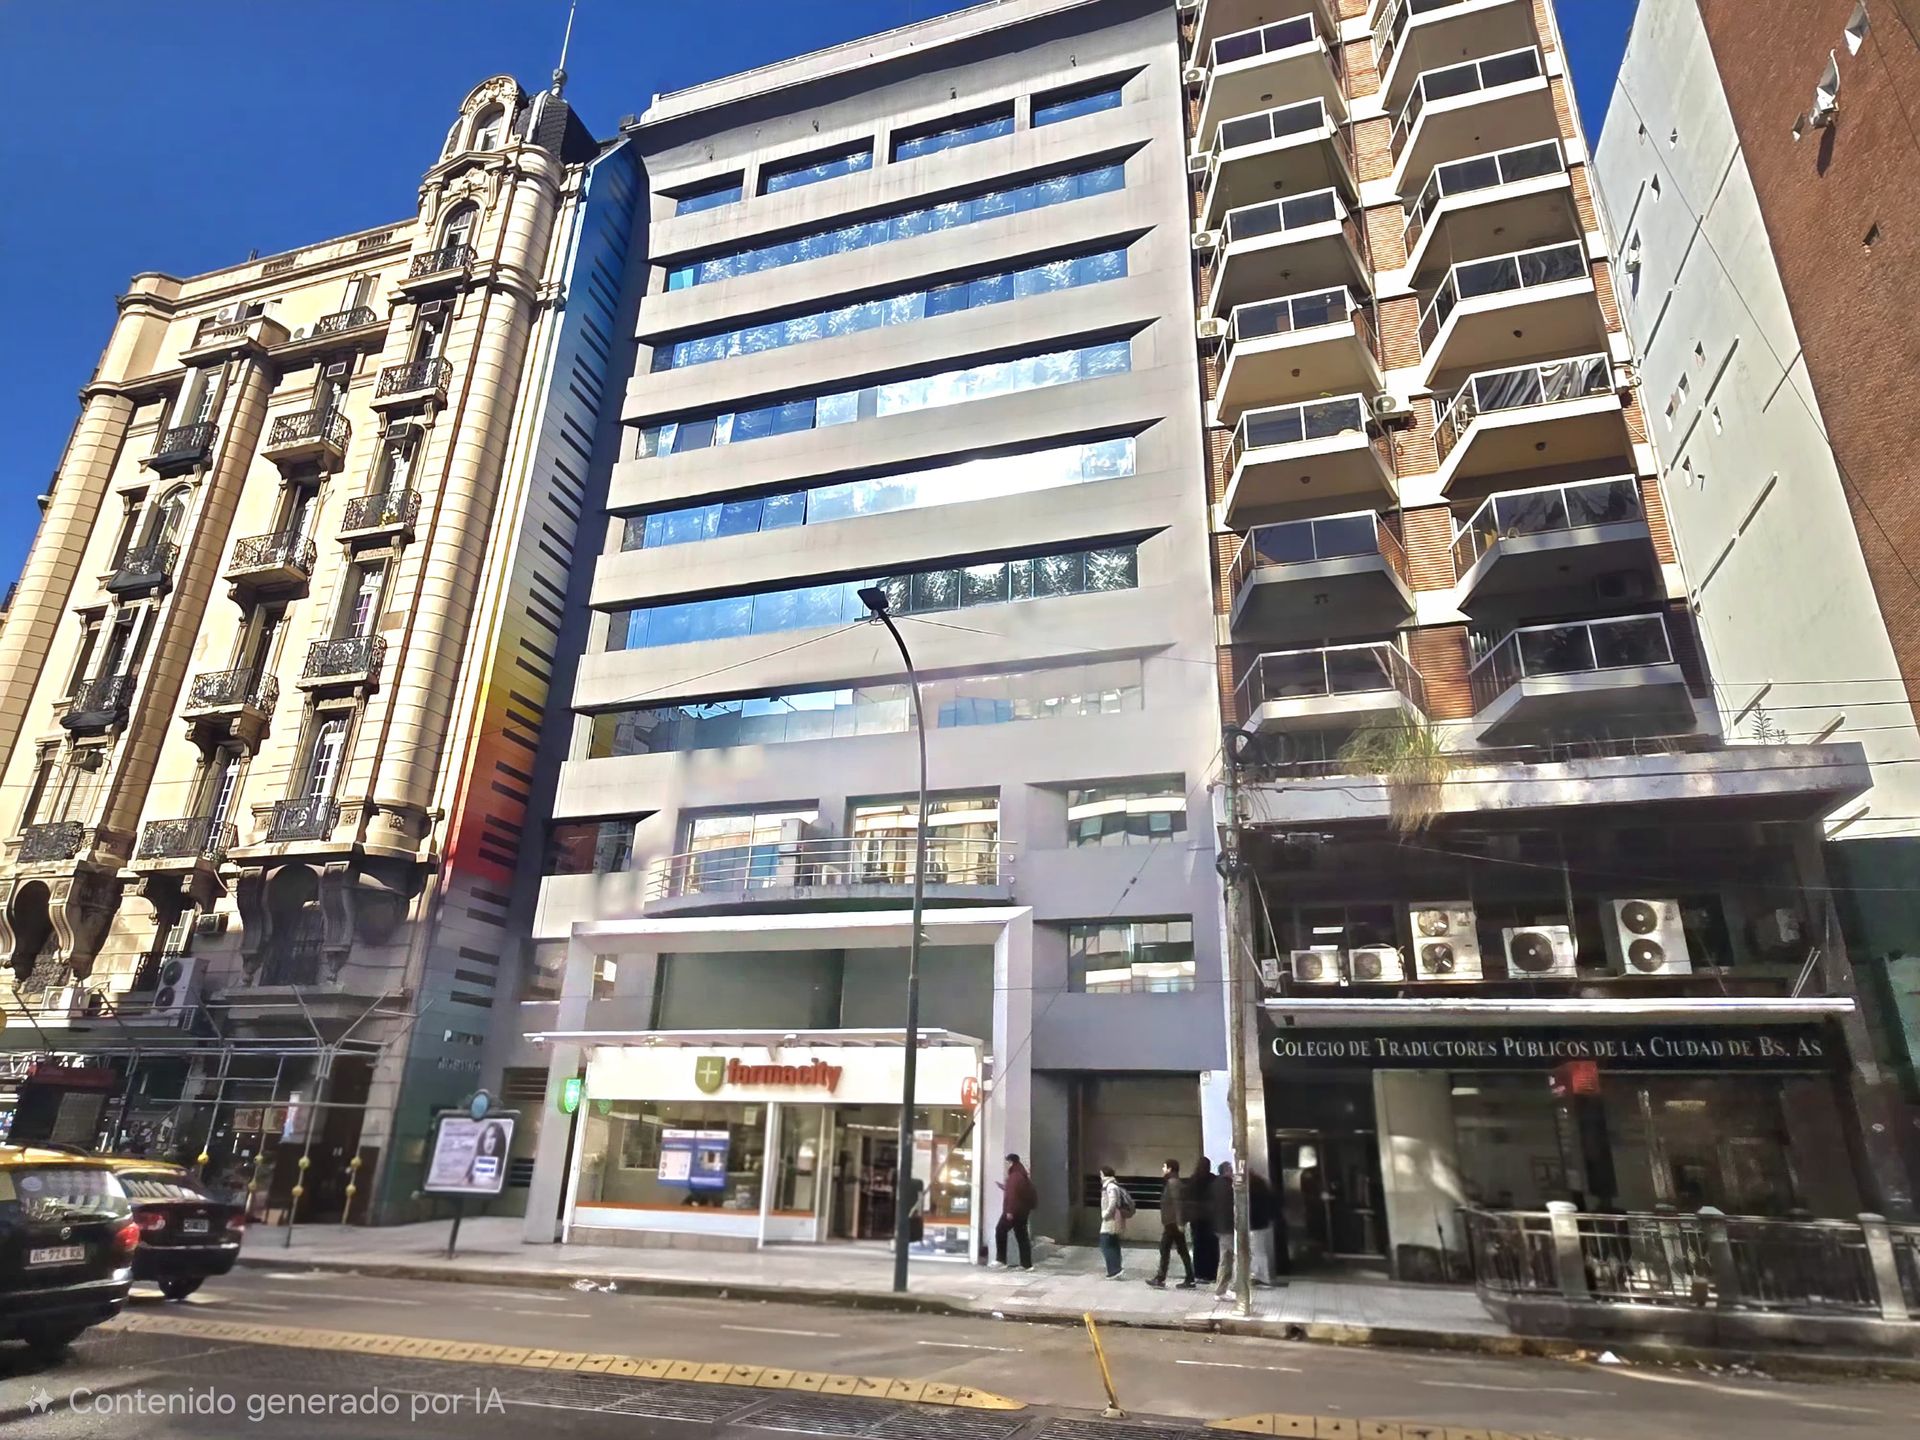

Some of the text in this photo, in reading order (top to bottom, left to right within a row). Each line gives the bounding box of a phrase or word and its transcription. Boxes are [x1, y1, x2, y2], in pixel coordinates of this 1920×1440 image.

[1272, 1037, 1345, 1057] COLEGIO
[1350, 1040, 1371, 1057] DE
[1375, 1037, 1497, 1057] TRADUCTORES
[1593, 1040, 1615, 1057] DE
[1622, 1040, 1646, 1057] LA
[1650, 1036, 1723, 1058] CIUDAD
[1728, 1040, 1751, 1056] DE
[727, 1057, 843, 1094] farmacity
